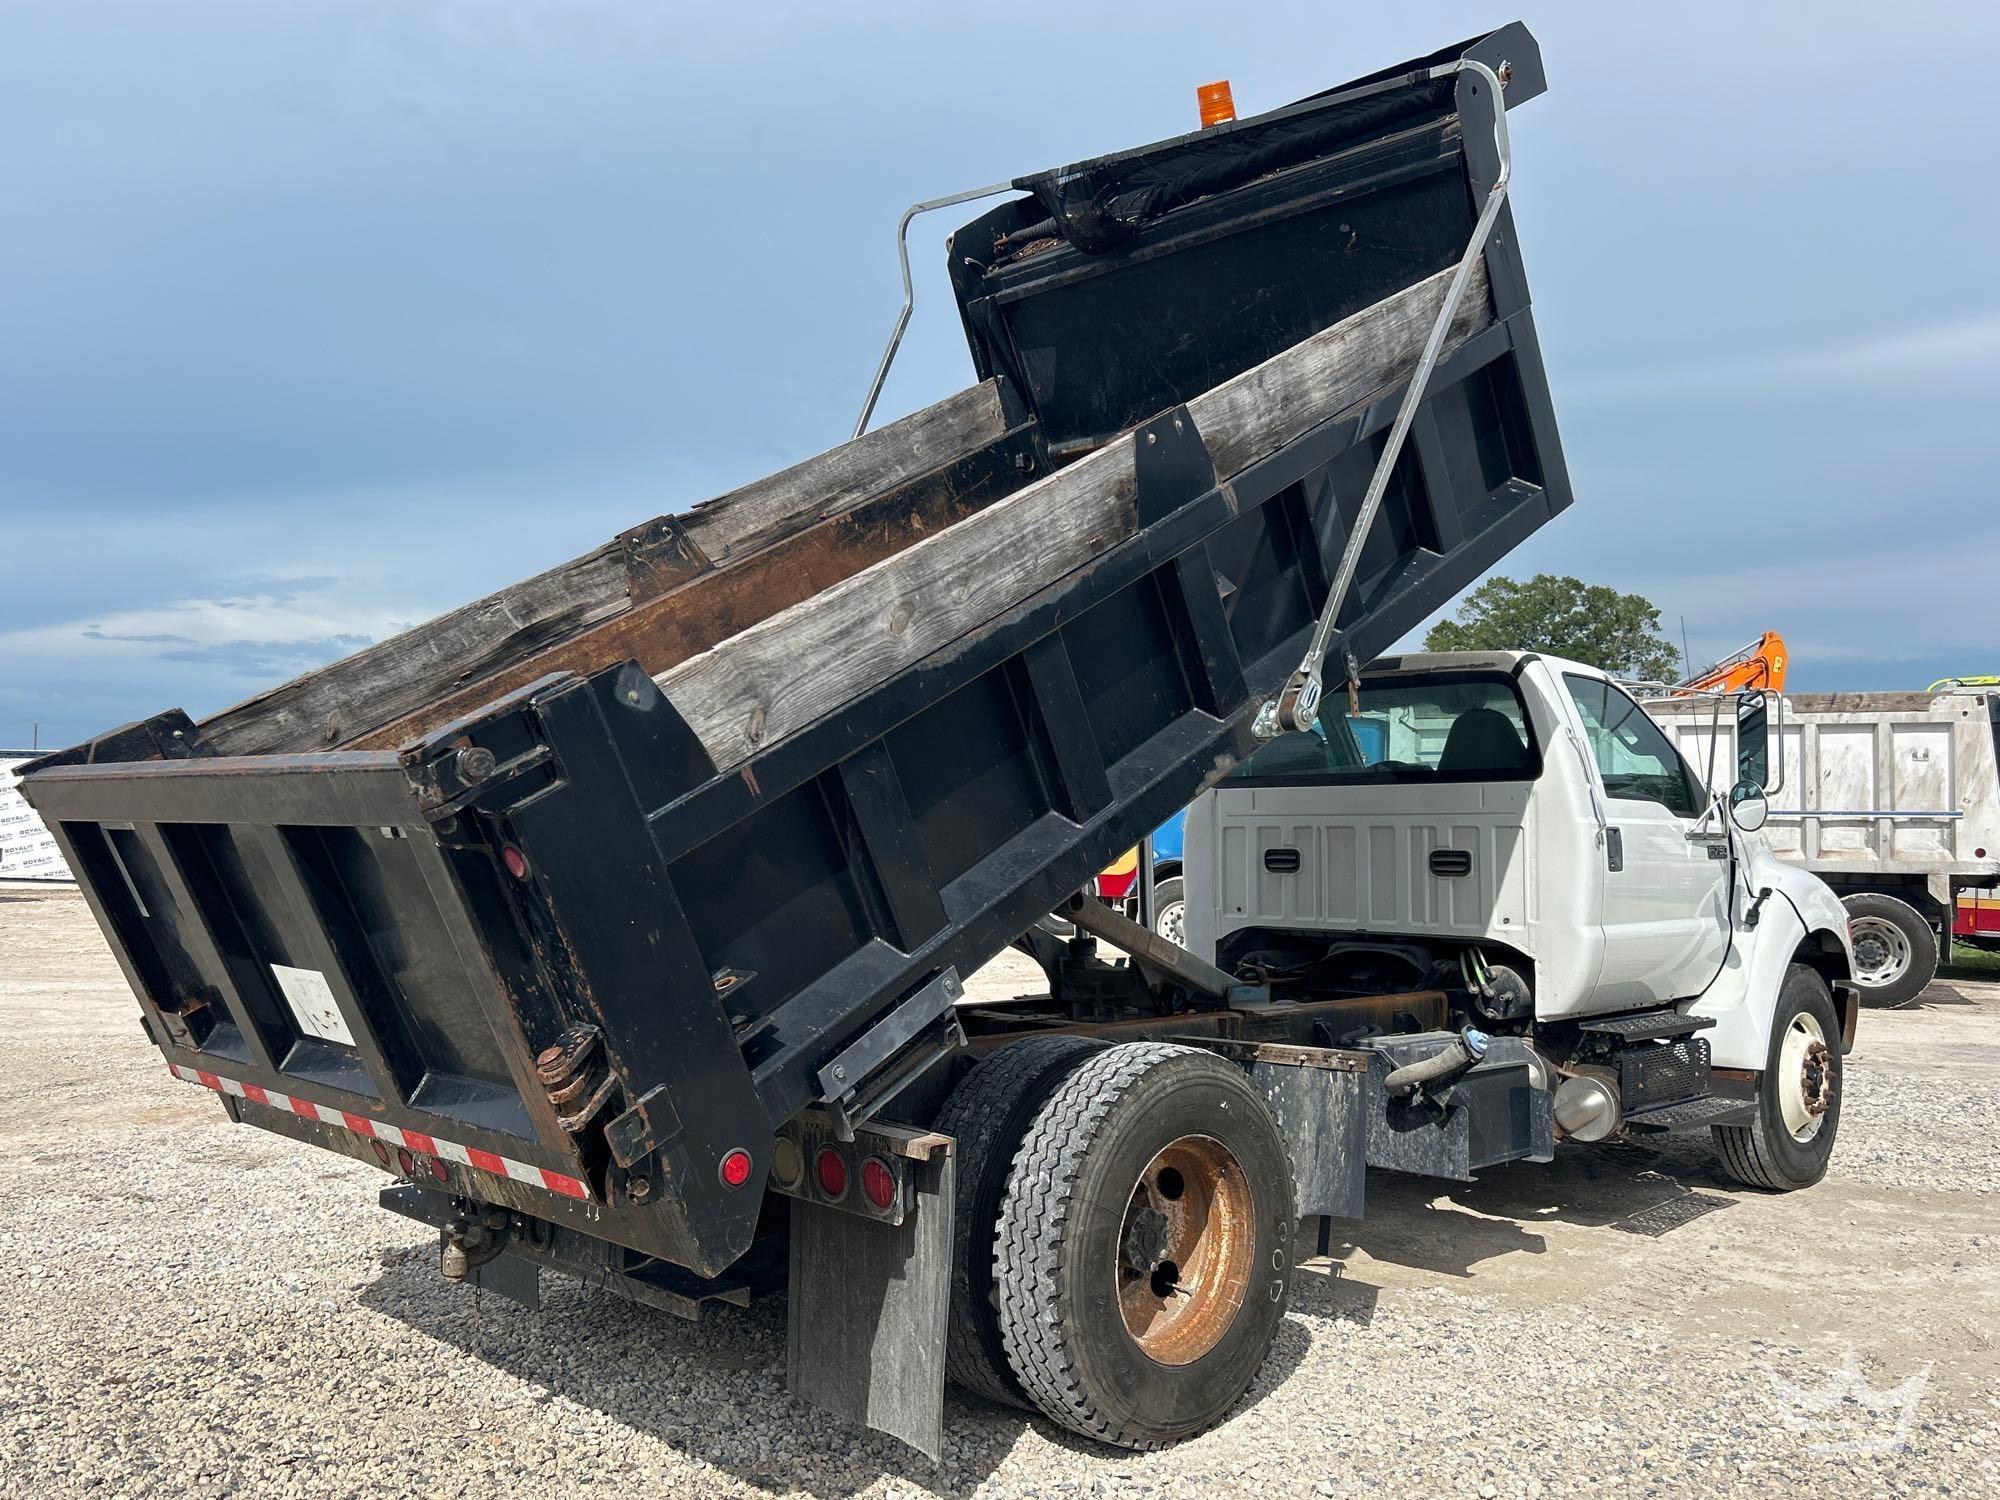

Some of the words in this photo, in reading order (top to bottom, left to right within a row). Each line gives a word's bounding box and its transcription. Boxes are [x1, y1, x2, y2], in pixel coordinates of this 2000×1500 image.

[1, 815, 24, 823] ROYAL
[20, 828, 42, 836] ROYAL
[5, 845, 27, 853] ROYAL
